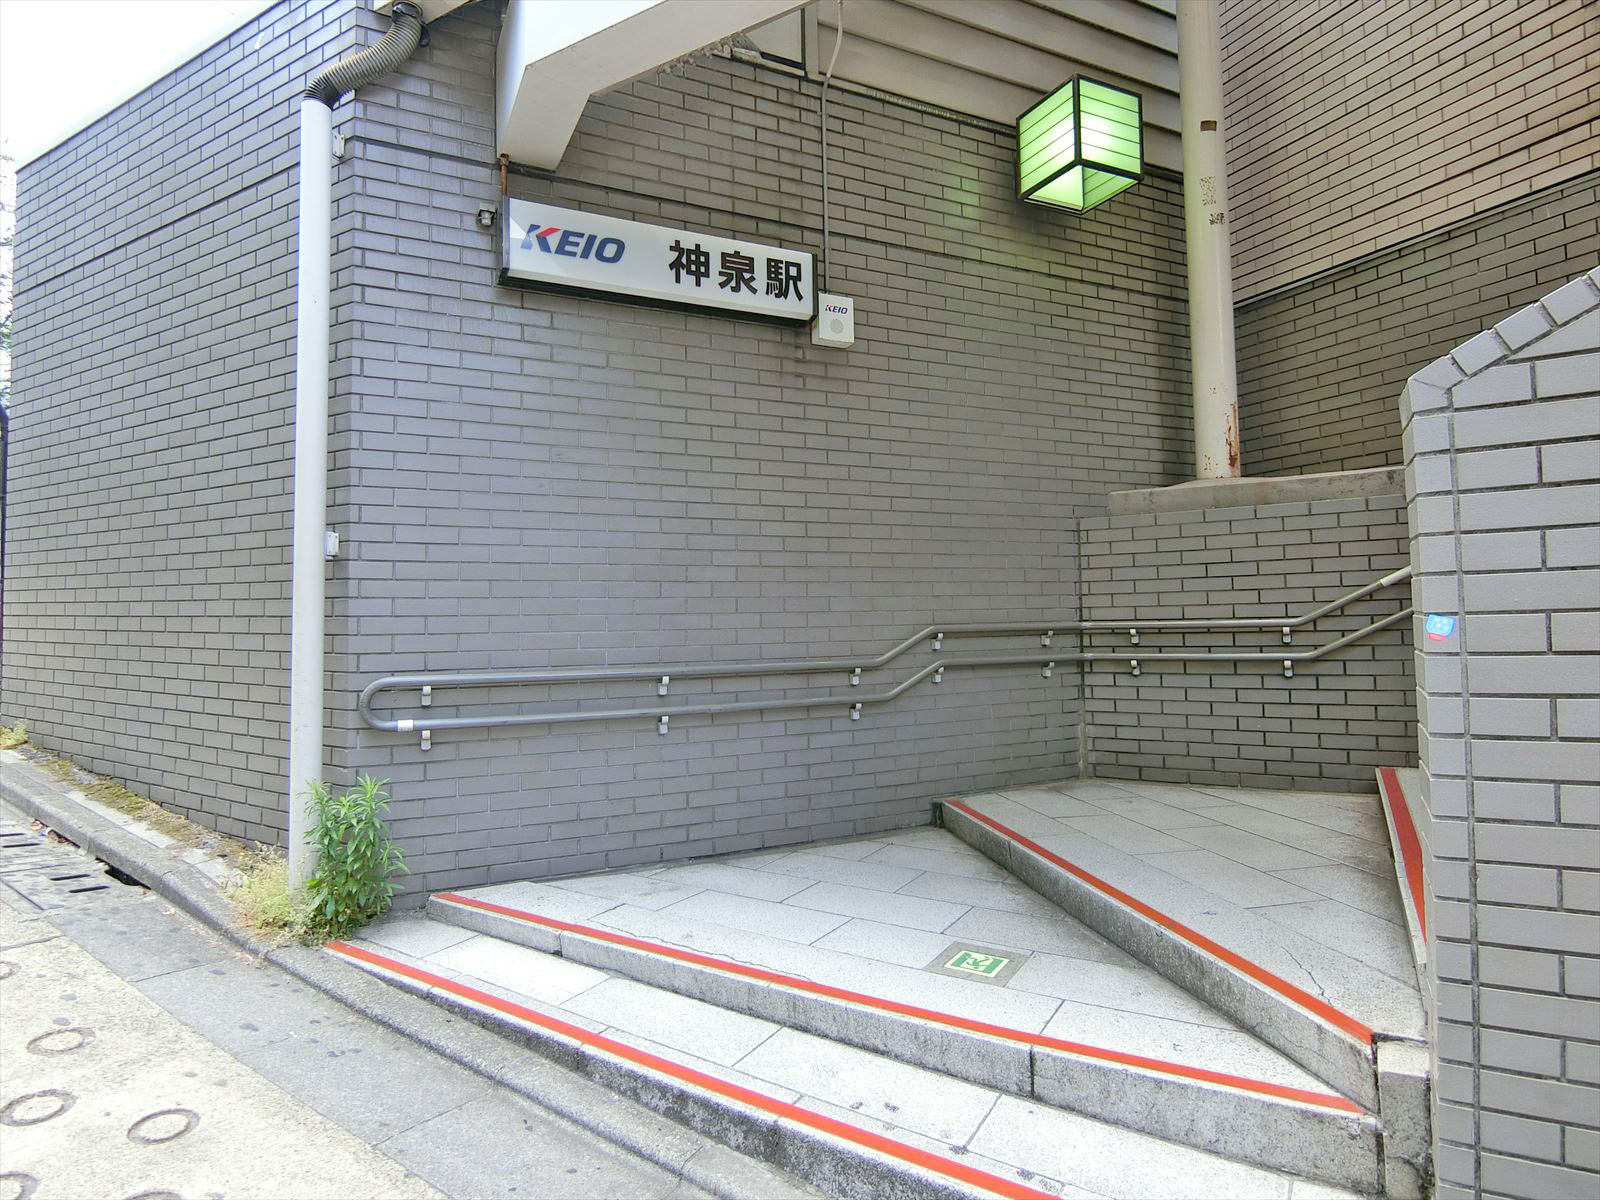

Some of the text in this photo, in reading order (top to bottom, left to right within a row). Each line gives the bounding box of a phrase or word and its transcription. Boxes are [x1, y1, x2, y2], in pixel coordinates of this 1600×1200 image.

[520, 223, 626, 264] KEIO
[669, 240, 803, 301] 神泉駅
[825, 304, 848, 314] KEIO
